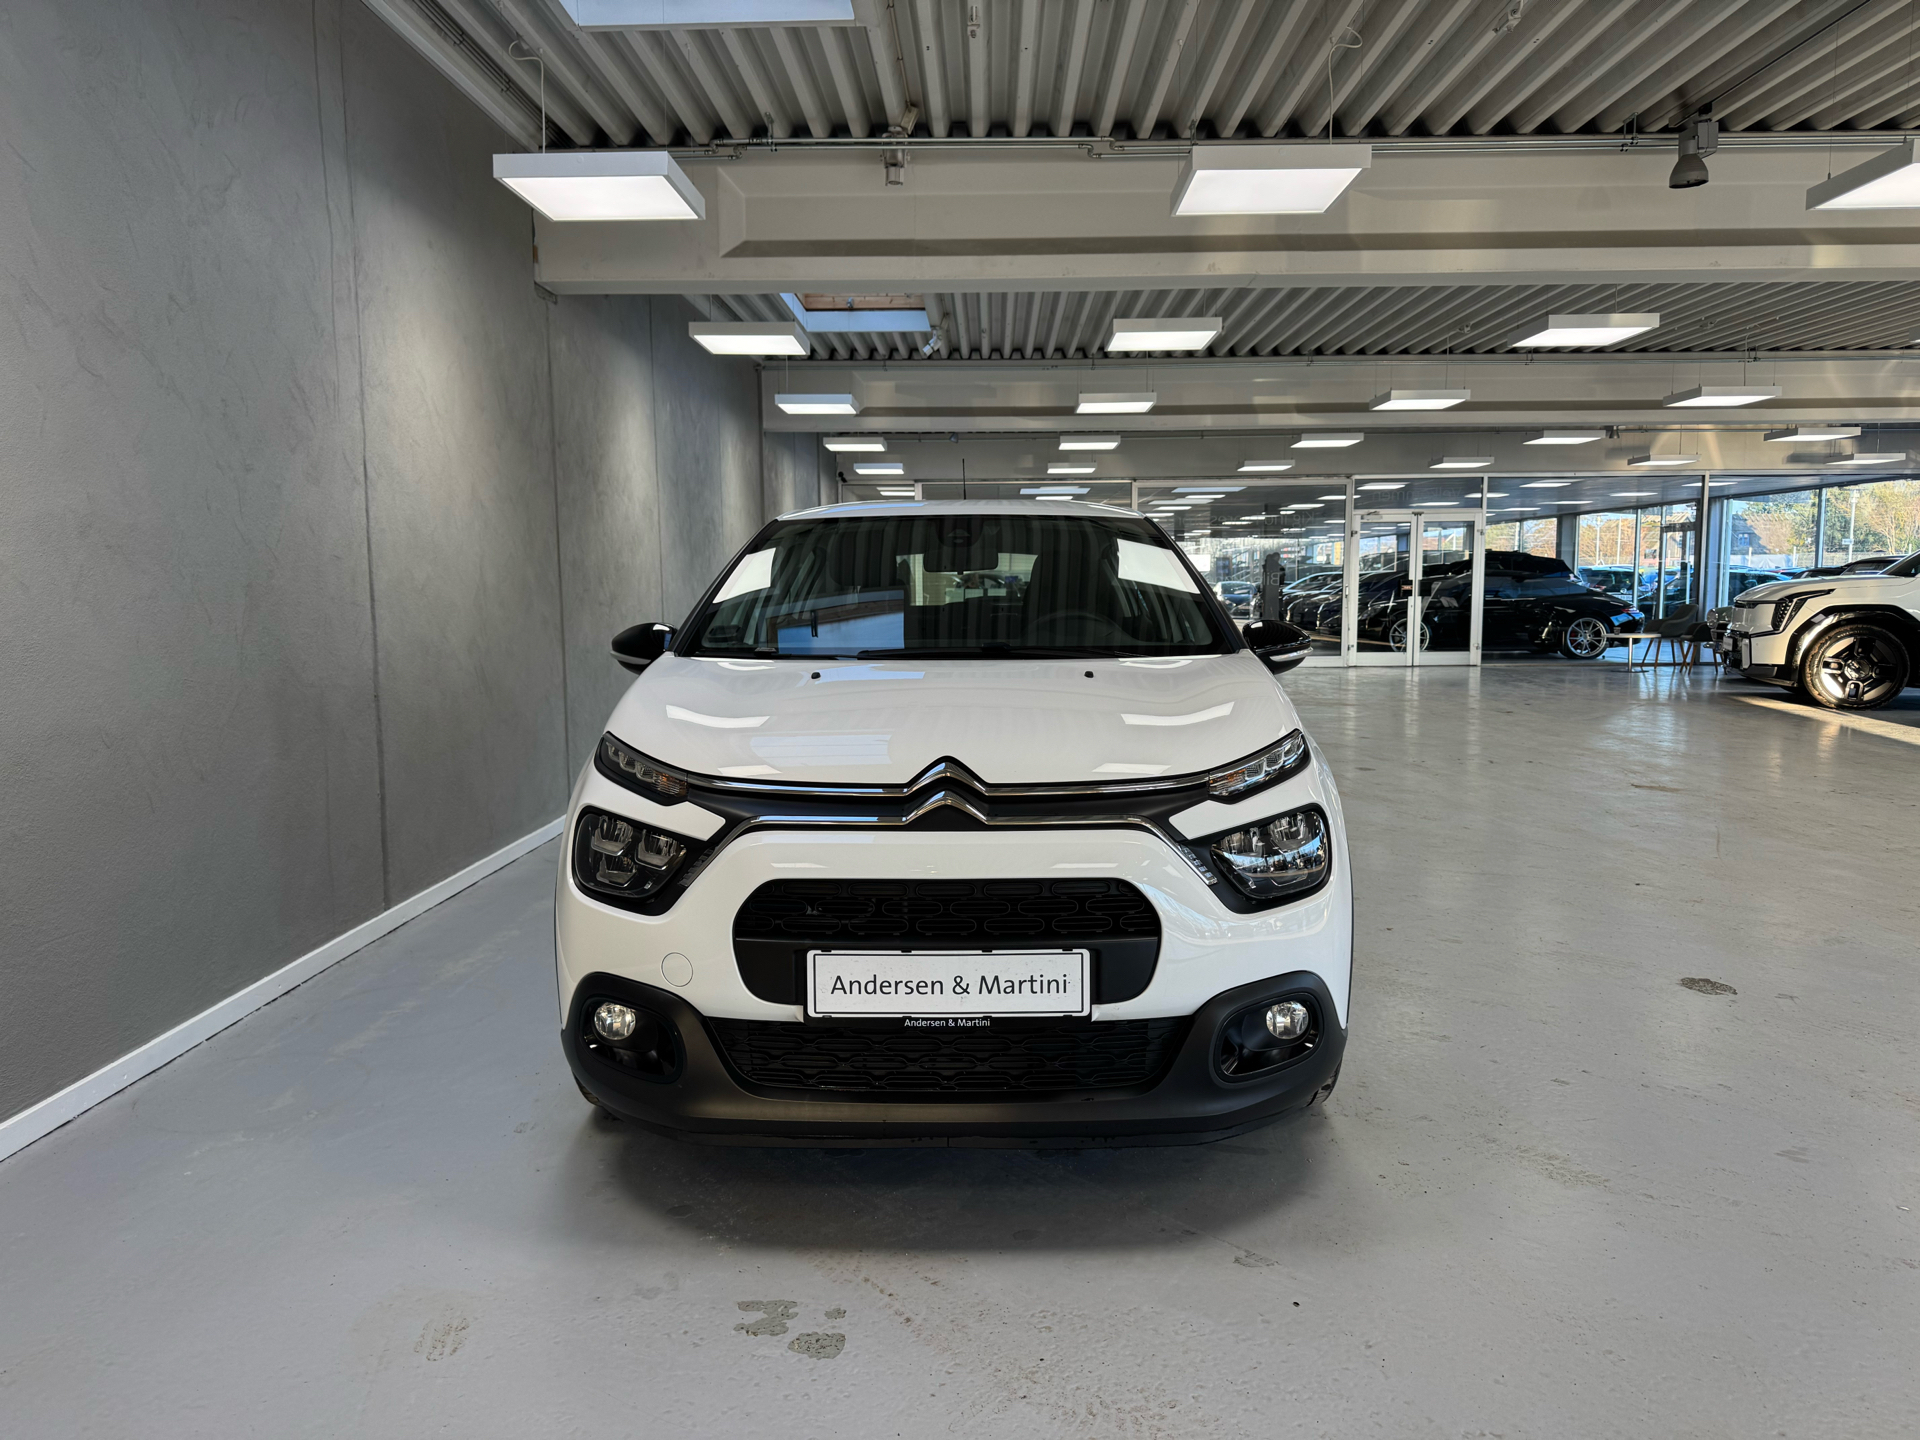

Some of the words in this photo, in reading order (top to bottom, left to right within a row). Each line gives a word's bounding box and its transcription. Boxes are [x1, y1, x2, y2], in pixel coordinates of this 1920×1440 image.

[830, 974, 944, 995] Andersen
[952, 975, 971, 995] &
[978, 974, 1067, 995] Martini
[904, 1018, 946, 1027] Andersen
[948, 1018, 956, 1027] &
[957, 1018, 991, 1027] Martini
